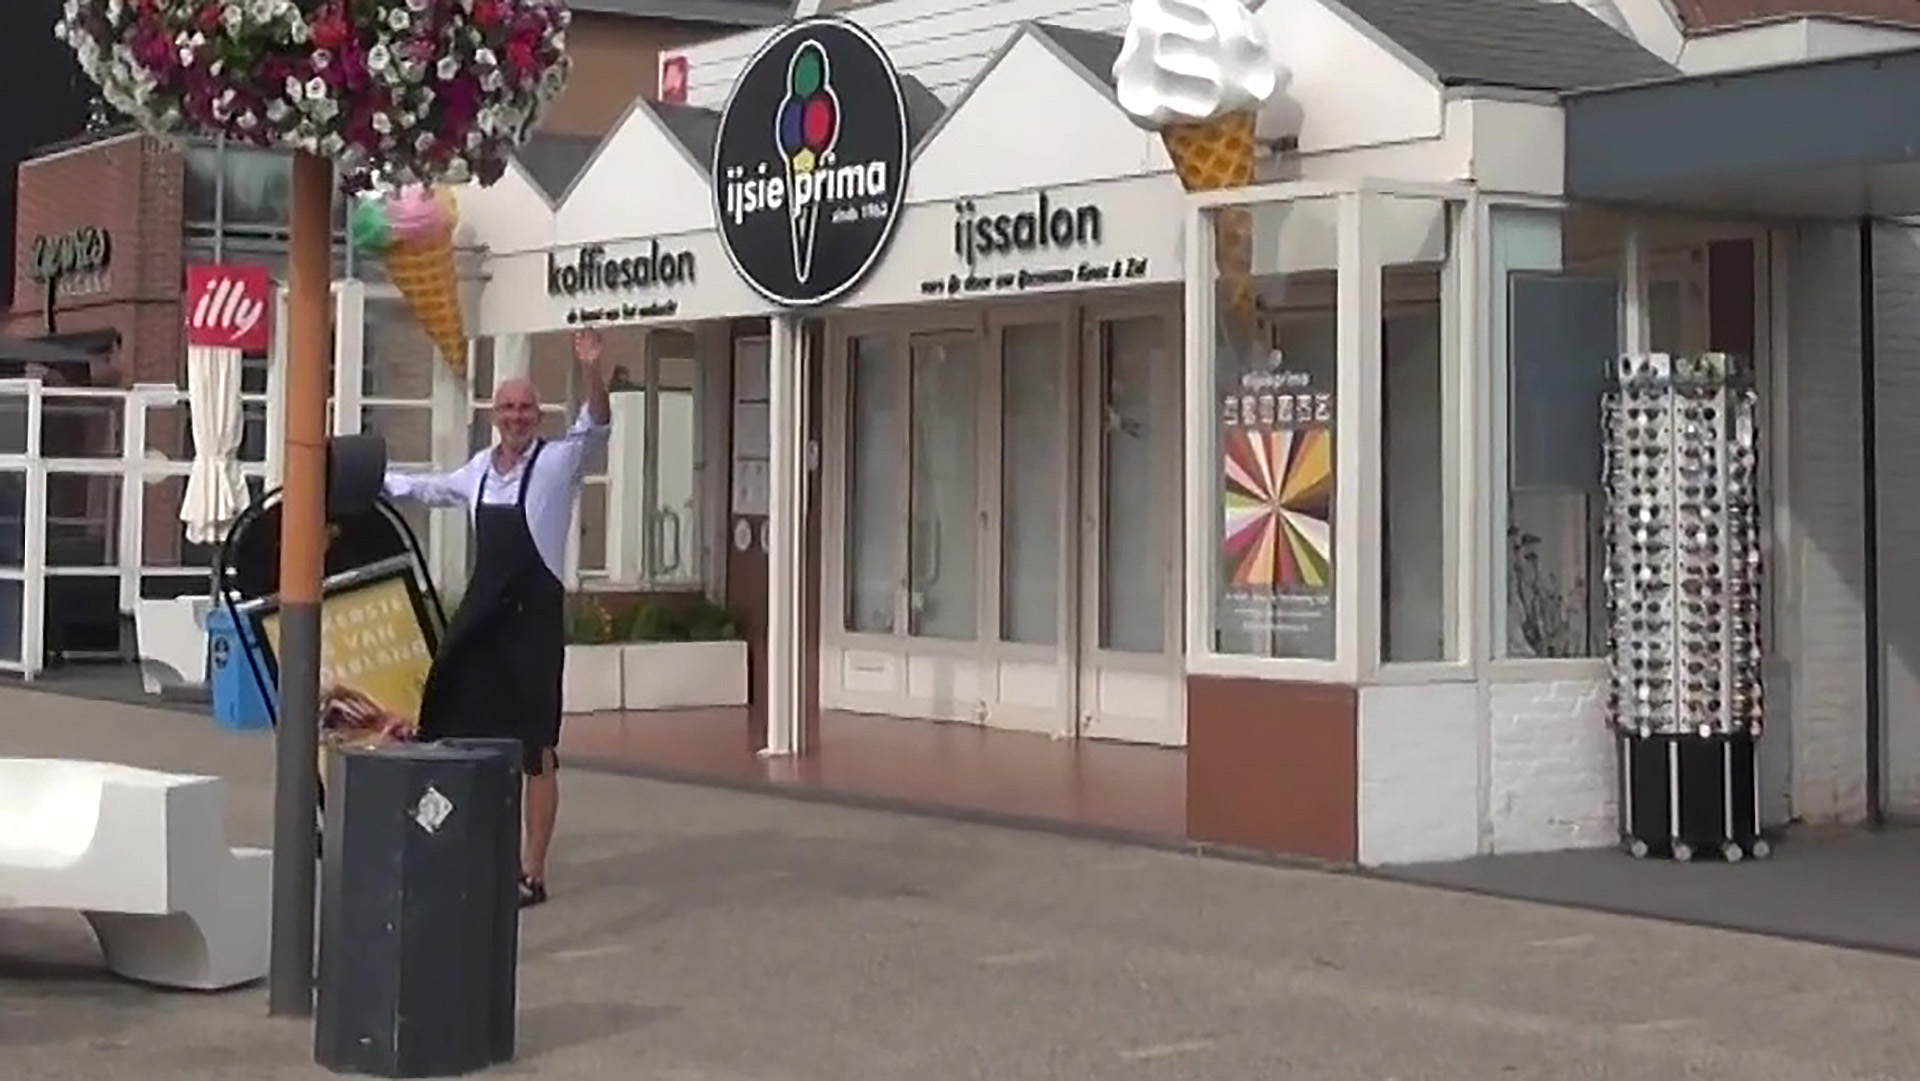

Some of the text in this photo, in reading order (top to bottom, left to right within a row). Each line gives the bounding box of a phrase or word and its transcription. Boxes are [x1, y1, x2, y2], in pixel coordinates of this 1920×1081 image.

[726, 151, 887, 225] ijsie prima
[955, 192, 1102, 267] ijssalon
[547, 239, 696, 296] koffiesalon
[193, 276, 264, 341] illy
